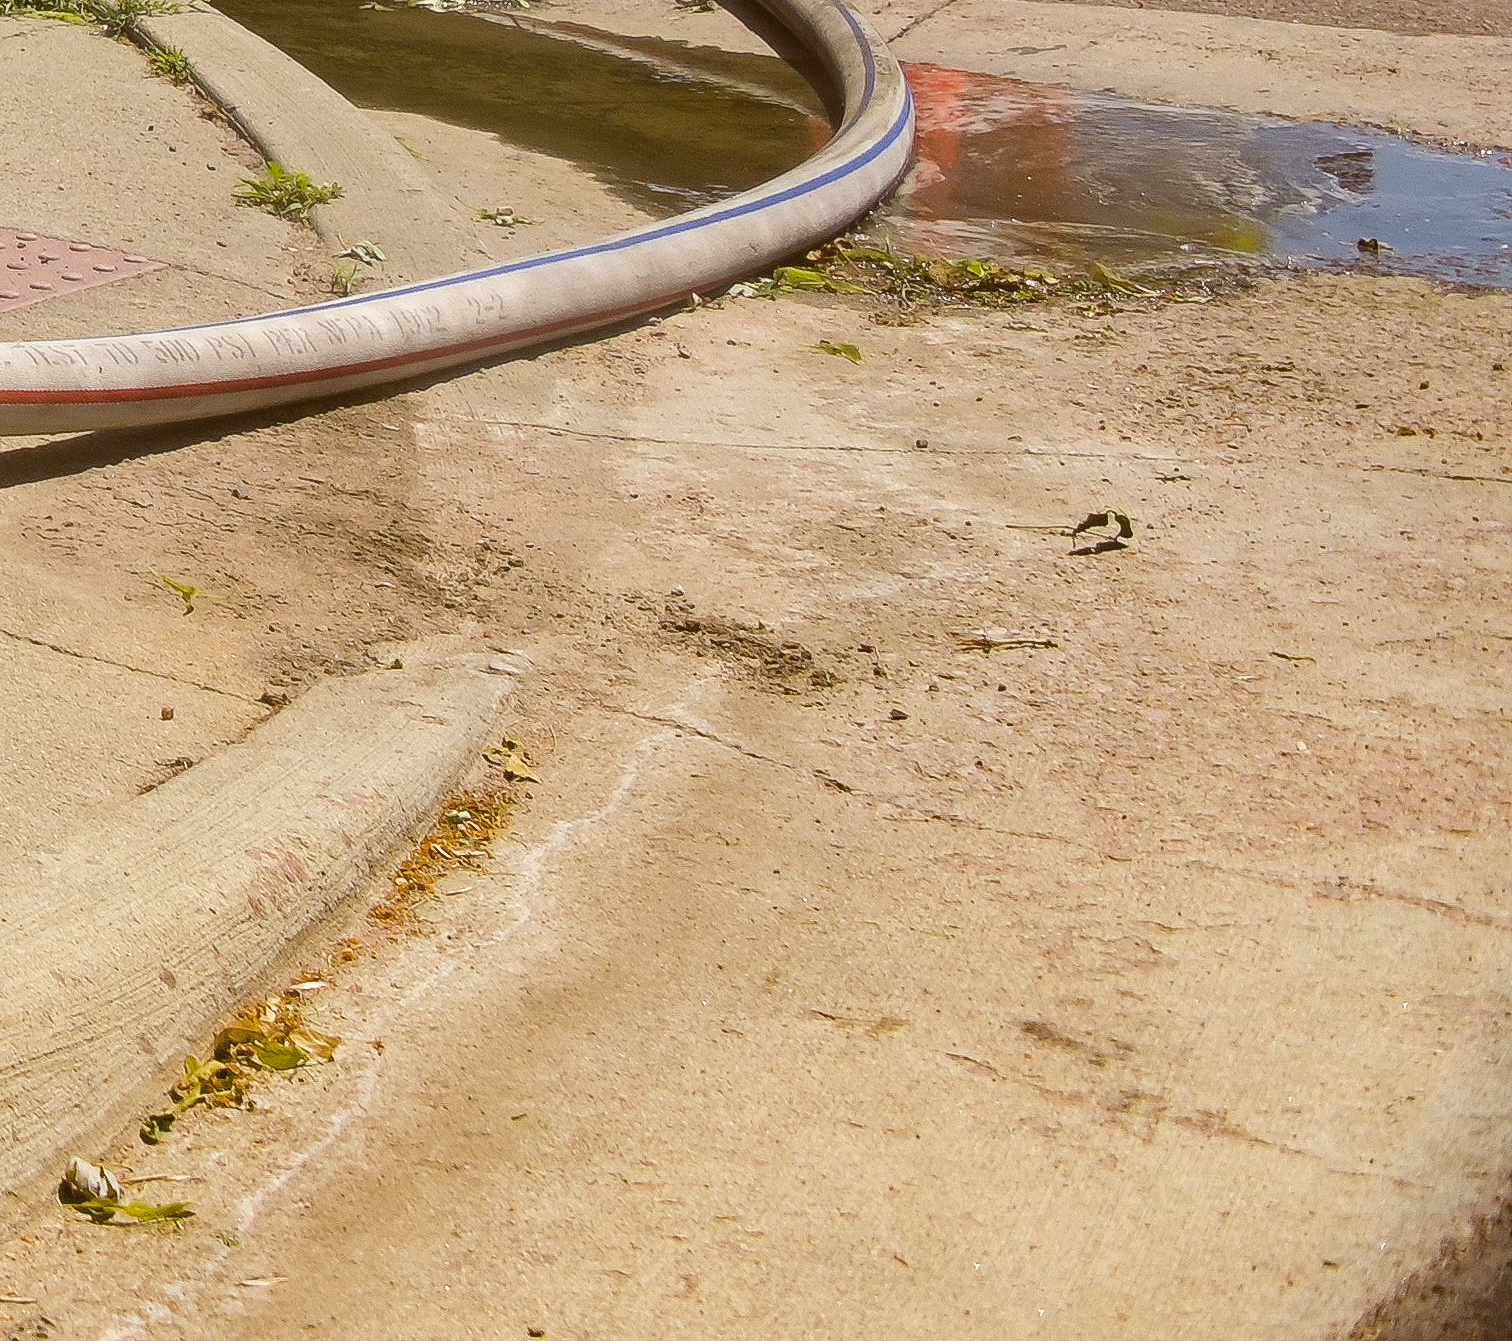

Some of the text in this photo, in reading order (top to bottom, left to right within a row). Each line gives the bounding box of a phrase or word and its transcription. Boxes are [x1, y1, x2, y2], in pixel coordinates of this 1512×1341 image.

[16, 342, 89, 366] TEST
[94, 341, 140, 365] TO
[205, 333, 257, 360] PSI
[261, 326, 318, 356] PER
[316, 315, 384, 346] NFPA
